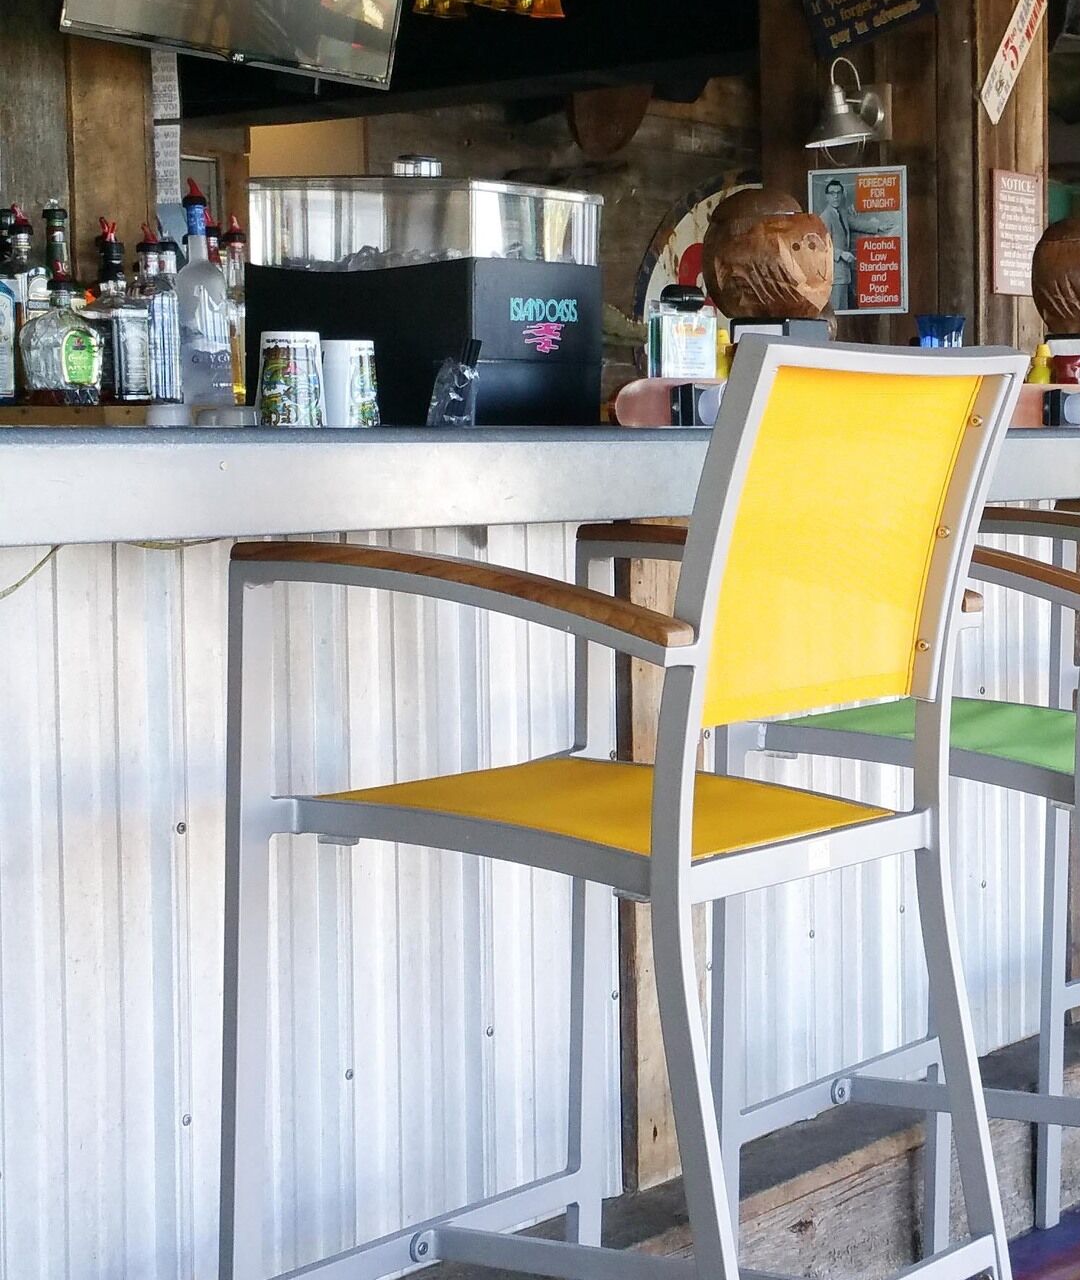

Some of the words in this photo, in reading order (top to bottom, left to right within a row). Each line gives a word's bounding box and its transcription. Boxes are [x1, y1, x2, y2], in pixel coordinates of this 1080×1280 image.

[823, 15, 836, 28] to
[232, 53, 244, 63] JVC
[858, 177, 897, 188] FORECAST
[1001, 177, 1036, 193] NOTICE:
[870, 188, 886, 198] FOR
[863, 240, 896, 251] Alcohol,
[870, 251, 887, 261] Low
[859, 261, 899, 272] Standards
[871, 272, 887, 282] and
[869, 283, 889, 293] Poor
[860, 293, 899, 304] Decisions
[510, 297, 545, 321] ISLAND
